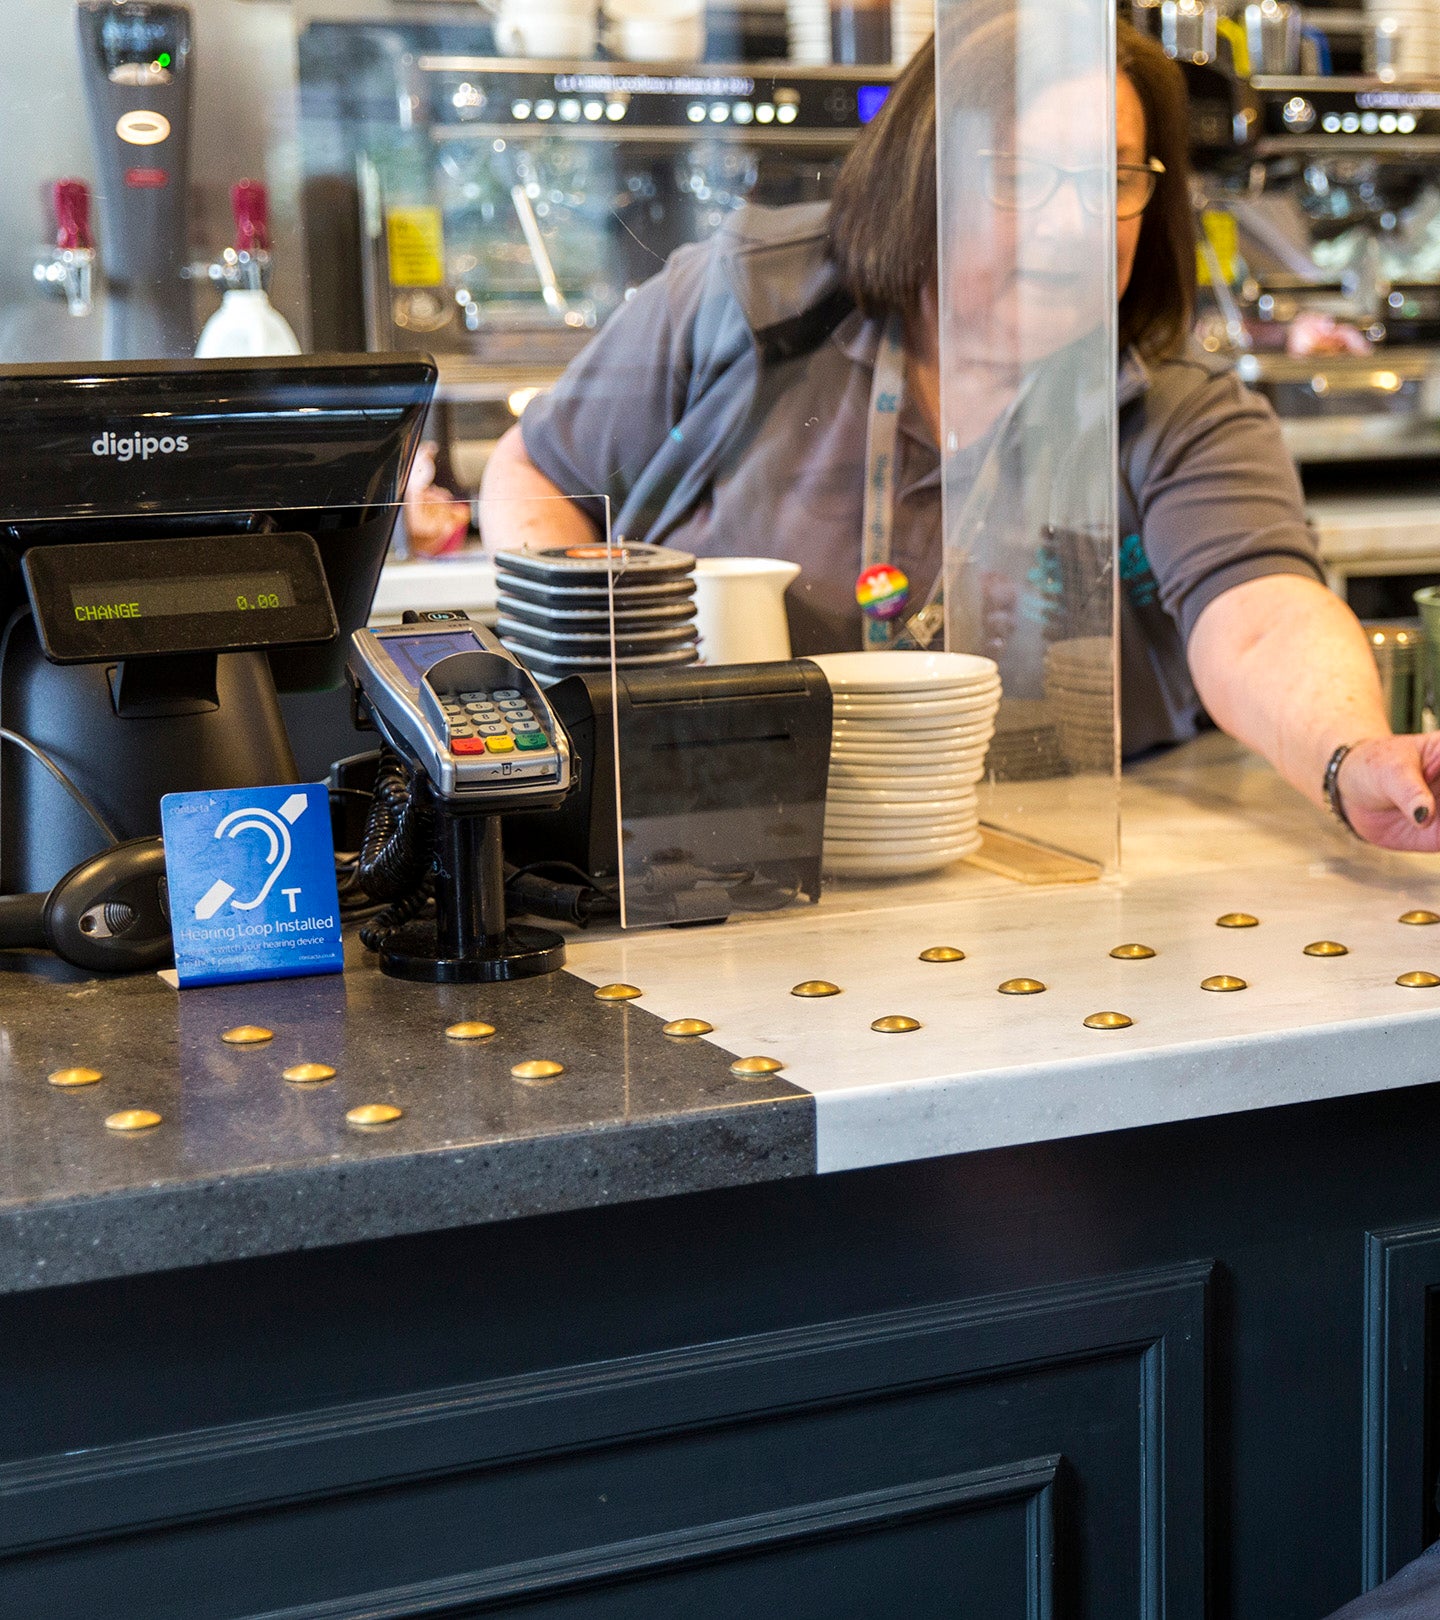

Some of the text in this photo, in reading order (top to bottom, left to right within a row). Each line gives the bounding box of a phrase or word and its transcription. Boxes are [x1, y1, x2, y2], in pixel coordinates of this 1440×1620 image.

[91, 430, 189, 461] digipos
[74, 593, 280, 621] CHANGE 0.00
[281, 887, 302, 913] T
[180, 916, 334, 941] Hearing Loop Installed
[213, 943, 241, 954] switch
[242, 941, 261, 953] your
[262, 938, 295, 950] hearing
[297, 936, 324, 946] device
